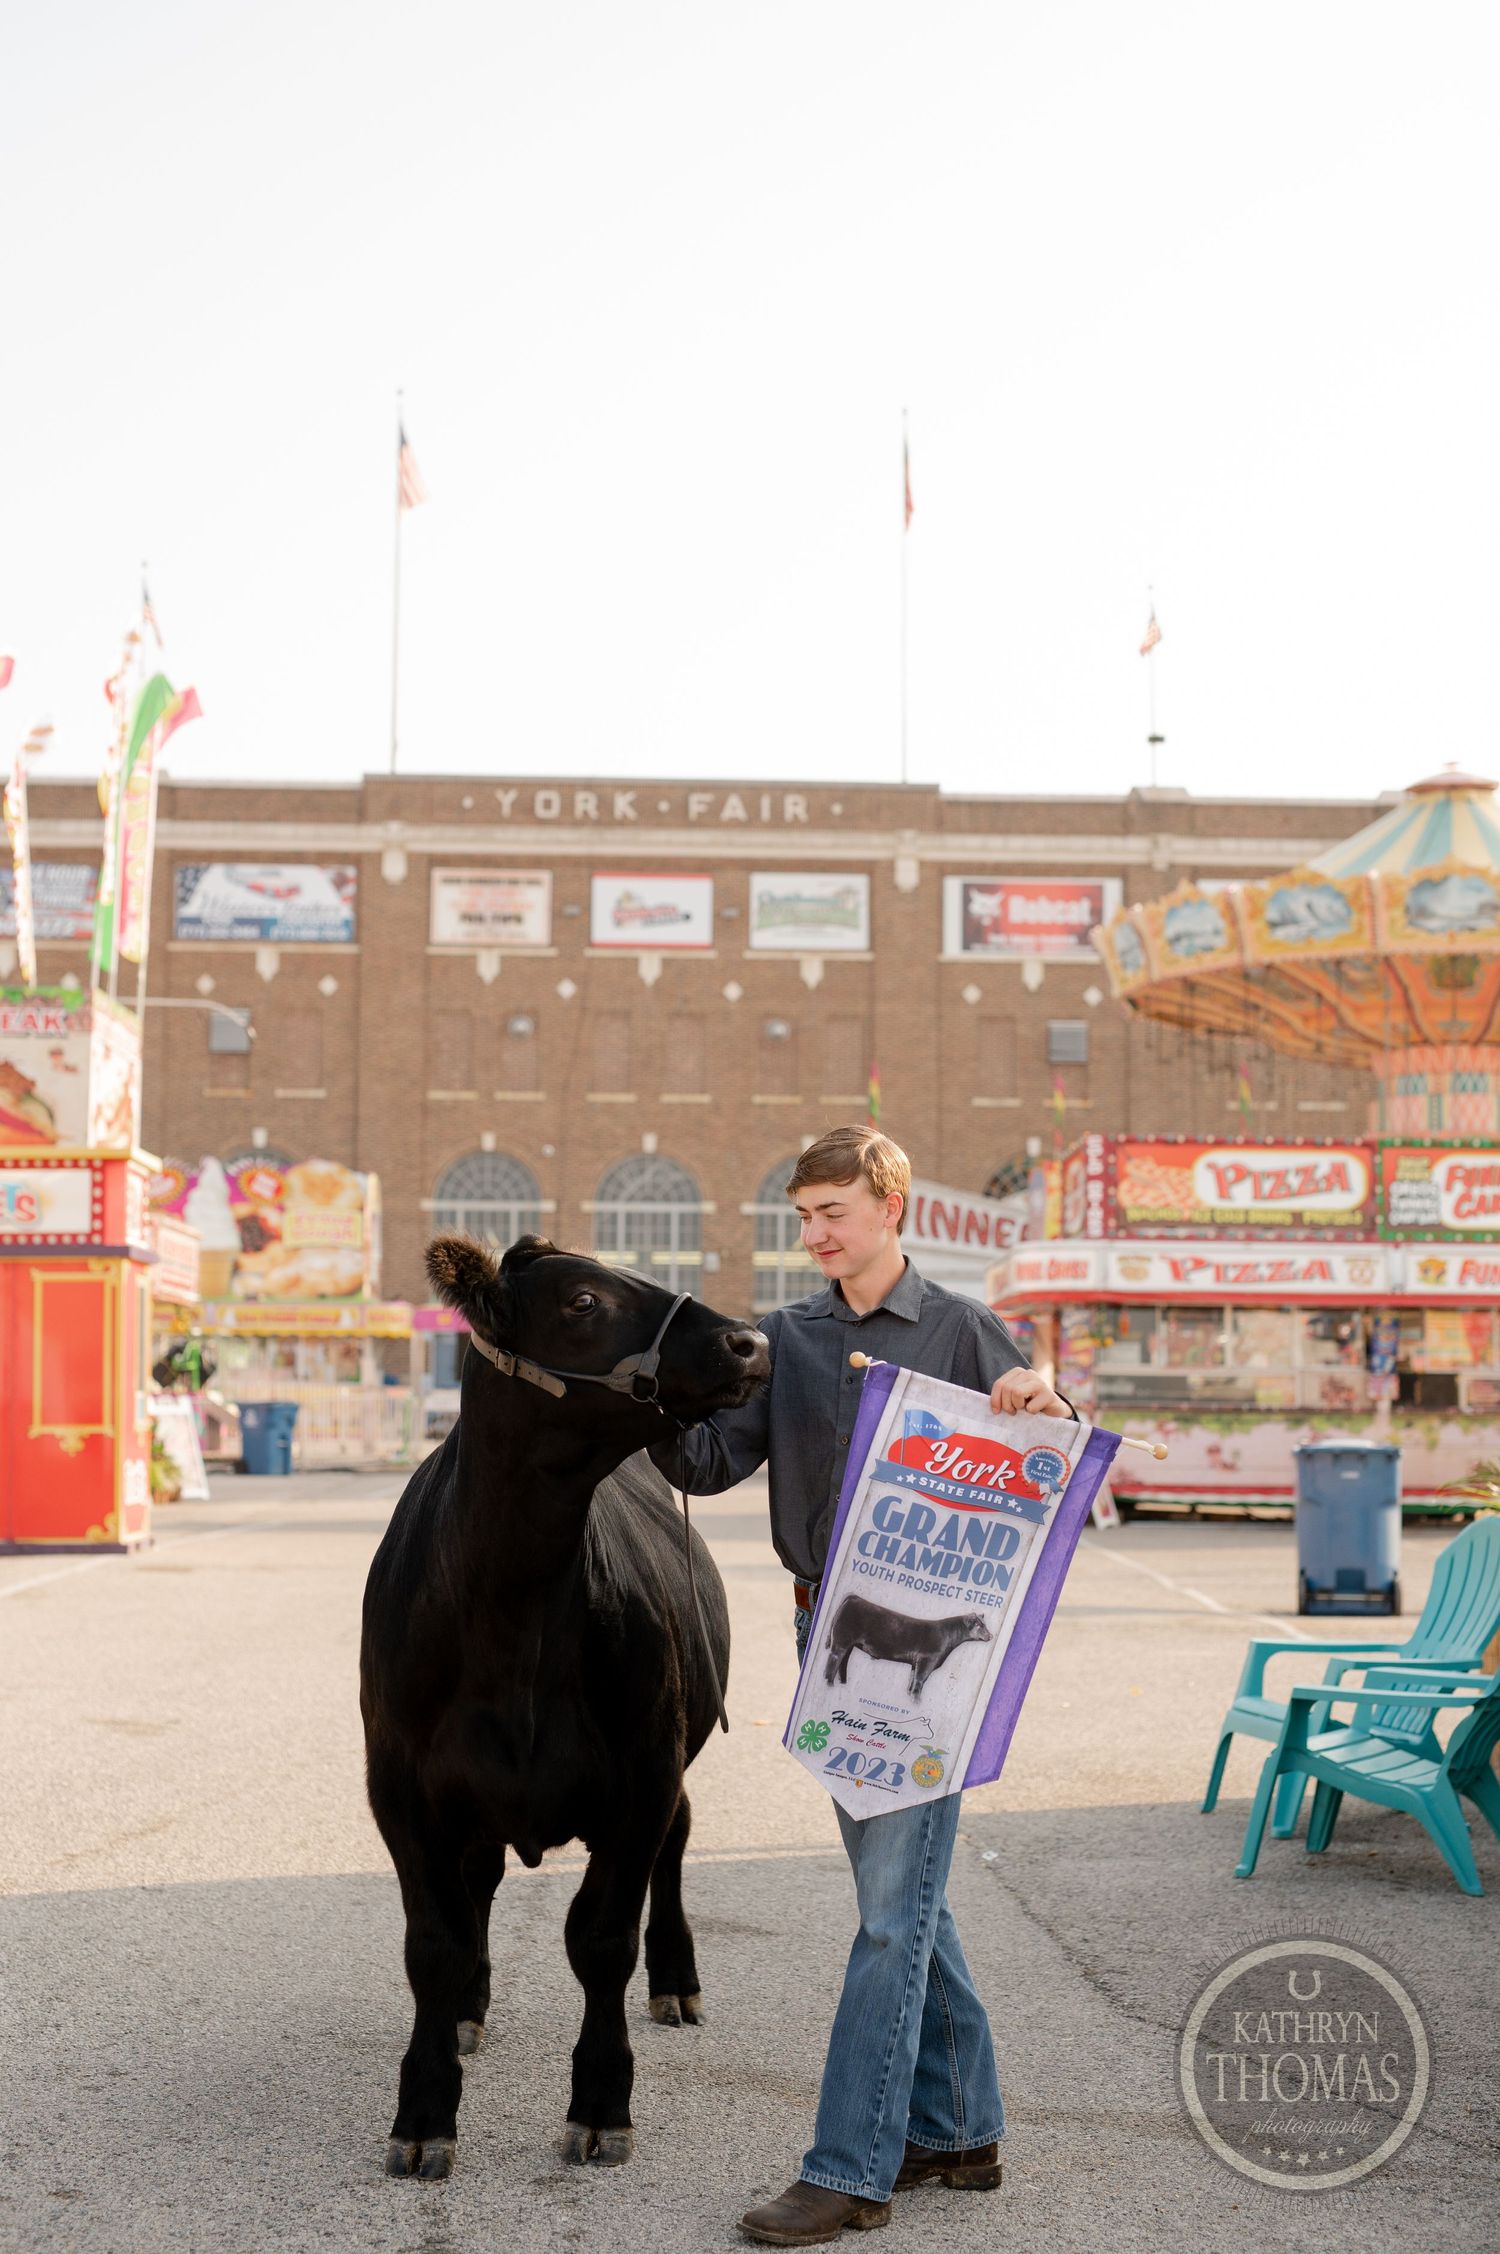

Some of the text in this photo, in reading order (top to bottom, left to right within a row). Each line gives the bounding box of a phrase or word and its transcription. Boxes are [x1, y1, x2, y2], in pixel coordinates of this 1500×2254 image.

[496, 788, 809, 823] YORK FAIR
[1446, 1164, 1500, 1192] FUN
[925, 1441, 1016, 1490] York
[1037, 1461, 1051, 1472] 1st
[919, 1476, 1004, 1505] STATE FAIR
[872, 1495, 1021, 1562] GRAND
[857, 1530, 1015, 1592] CHAMPION
[852, 1558, 1004, 1609] YOUTH PROSPECT STEER
[859, 1697, 911, 1716] SPONSORED BY
[831, 1710, 912, 1742] Hain Farm
[846, 1733, 887, 1750] Show Cattle
[824, 1746, 906, 1787] 2023
